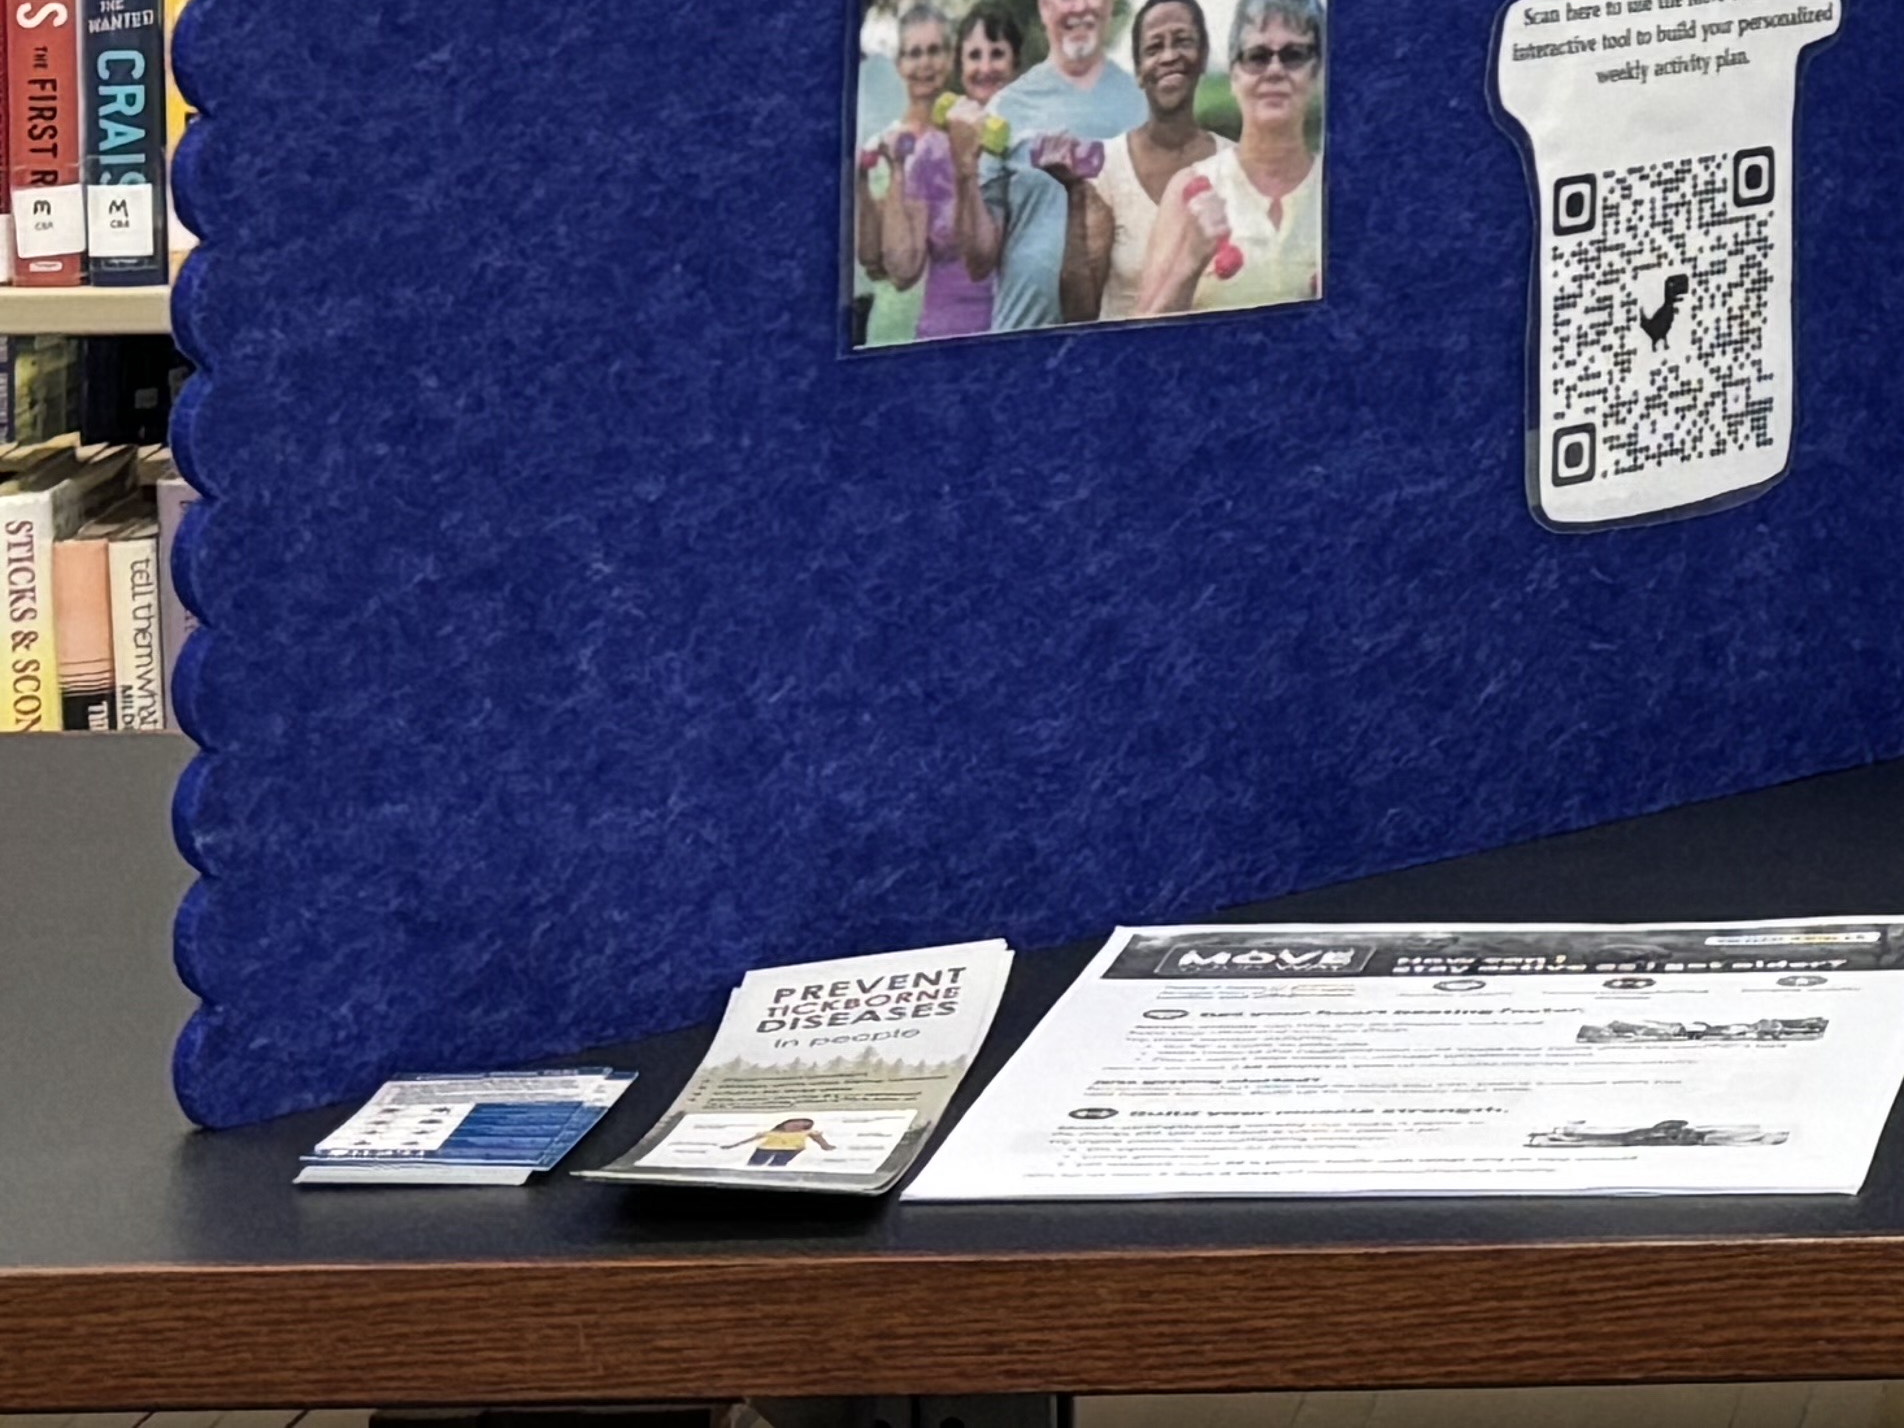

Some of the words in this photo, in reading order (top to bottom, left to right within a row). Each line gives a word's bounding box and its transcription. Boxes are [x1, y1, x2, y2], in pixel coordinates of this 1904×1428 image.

[32, 45, 49, 70] THE
[27, 77, 58, 160] FIRST
[5, 519, 39, 623] STICKS
[10, 630, 37, 653] &
[773, 967, 966, 1004] PREVENT
[756, 1001, 958, 1033] DISEASES
[766, 986, 961, 1018] TICKBORNE
